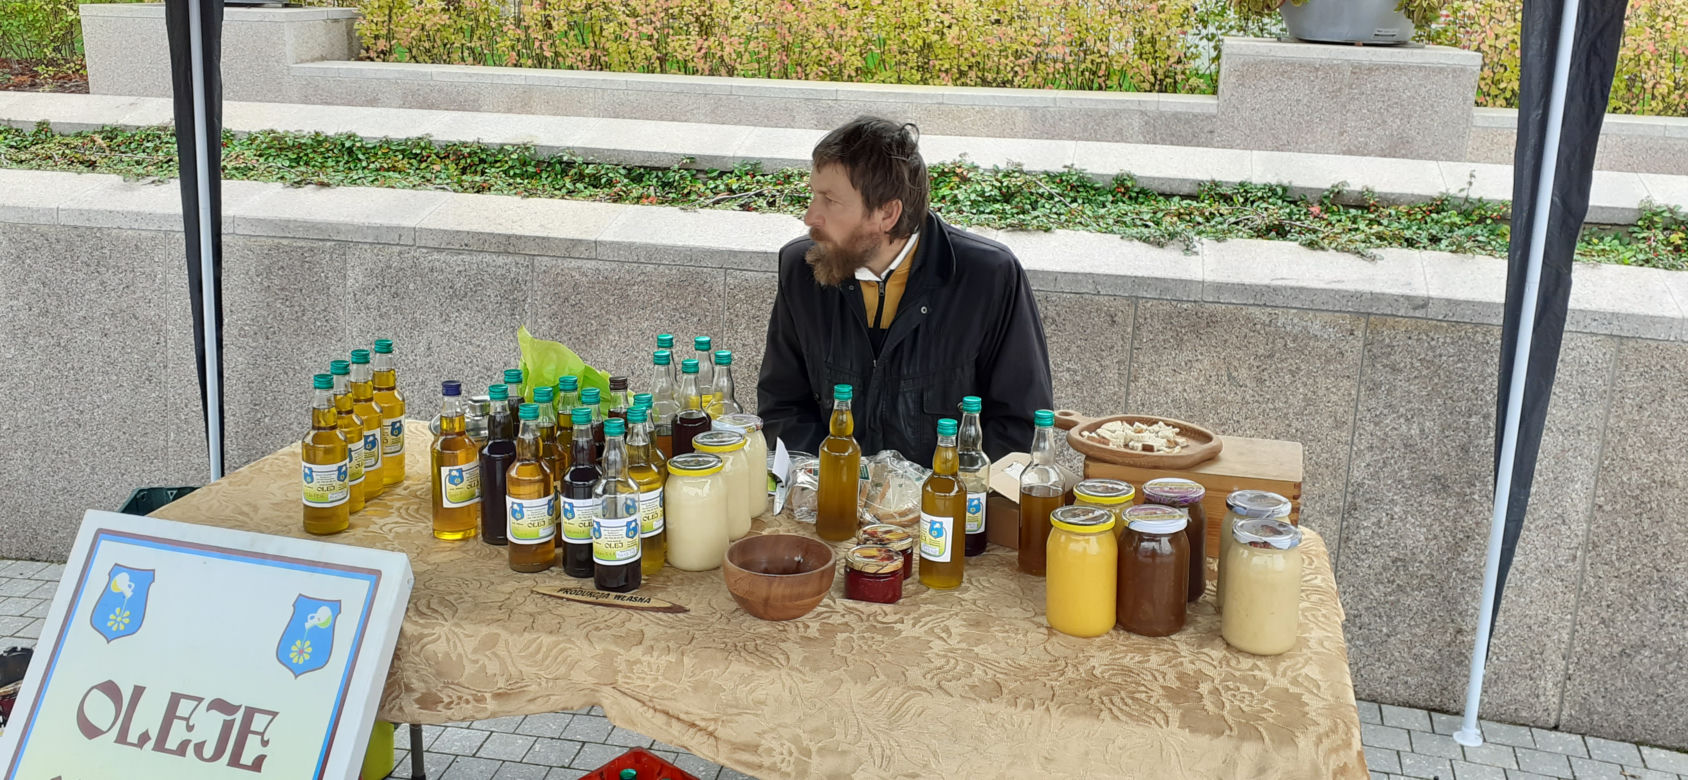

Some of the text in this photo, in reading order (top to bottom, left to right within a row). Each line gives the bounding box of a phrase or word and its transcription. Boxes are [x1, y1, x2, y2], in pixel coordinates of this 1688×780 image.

[642, 512, 659, 522] OLEJ
[527, 520, 546, 528] OLEJ
[557, 587, 652, 604] PRODUKCJA WŁASNA
[76, 679, 280, 773] OLEJE
